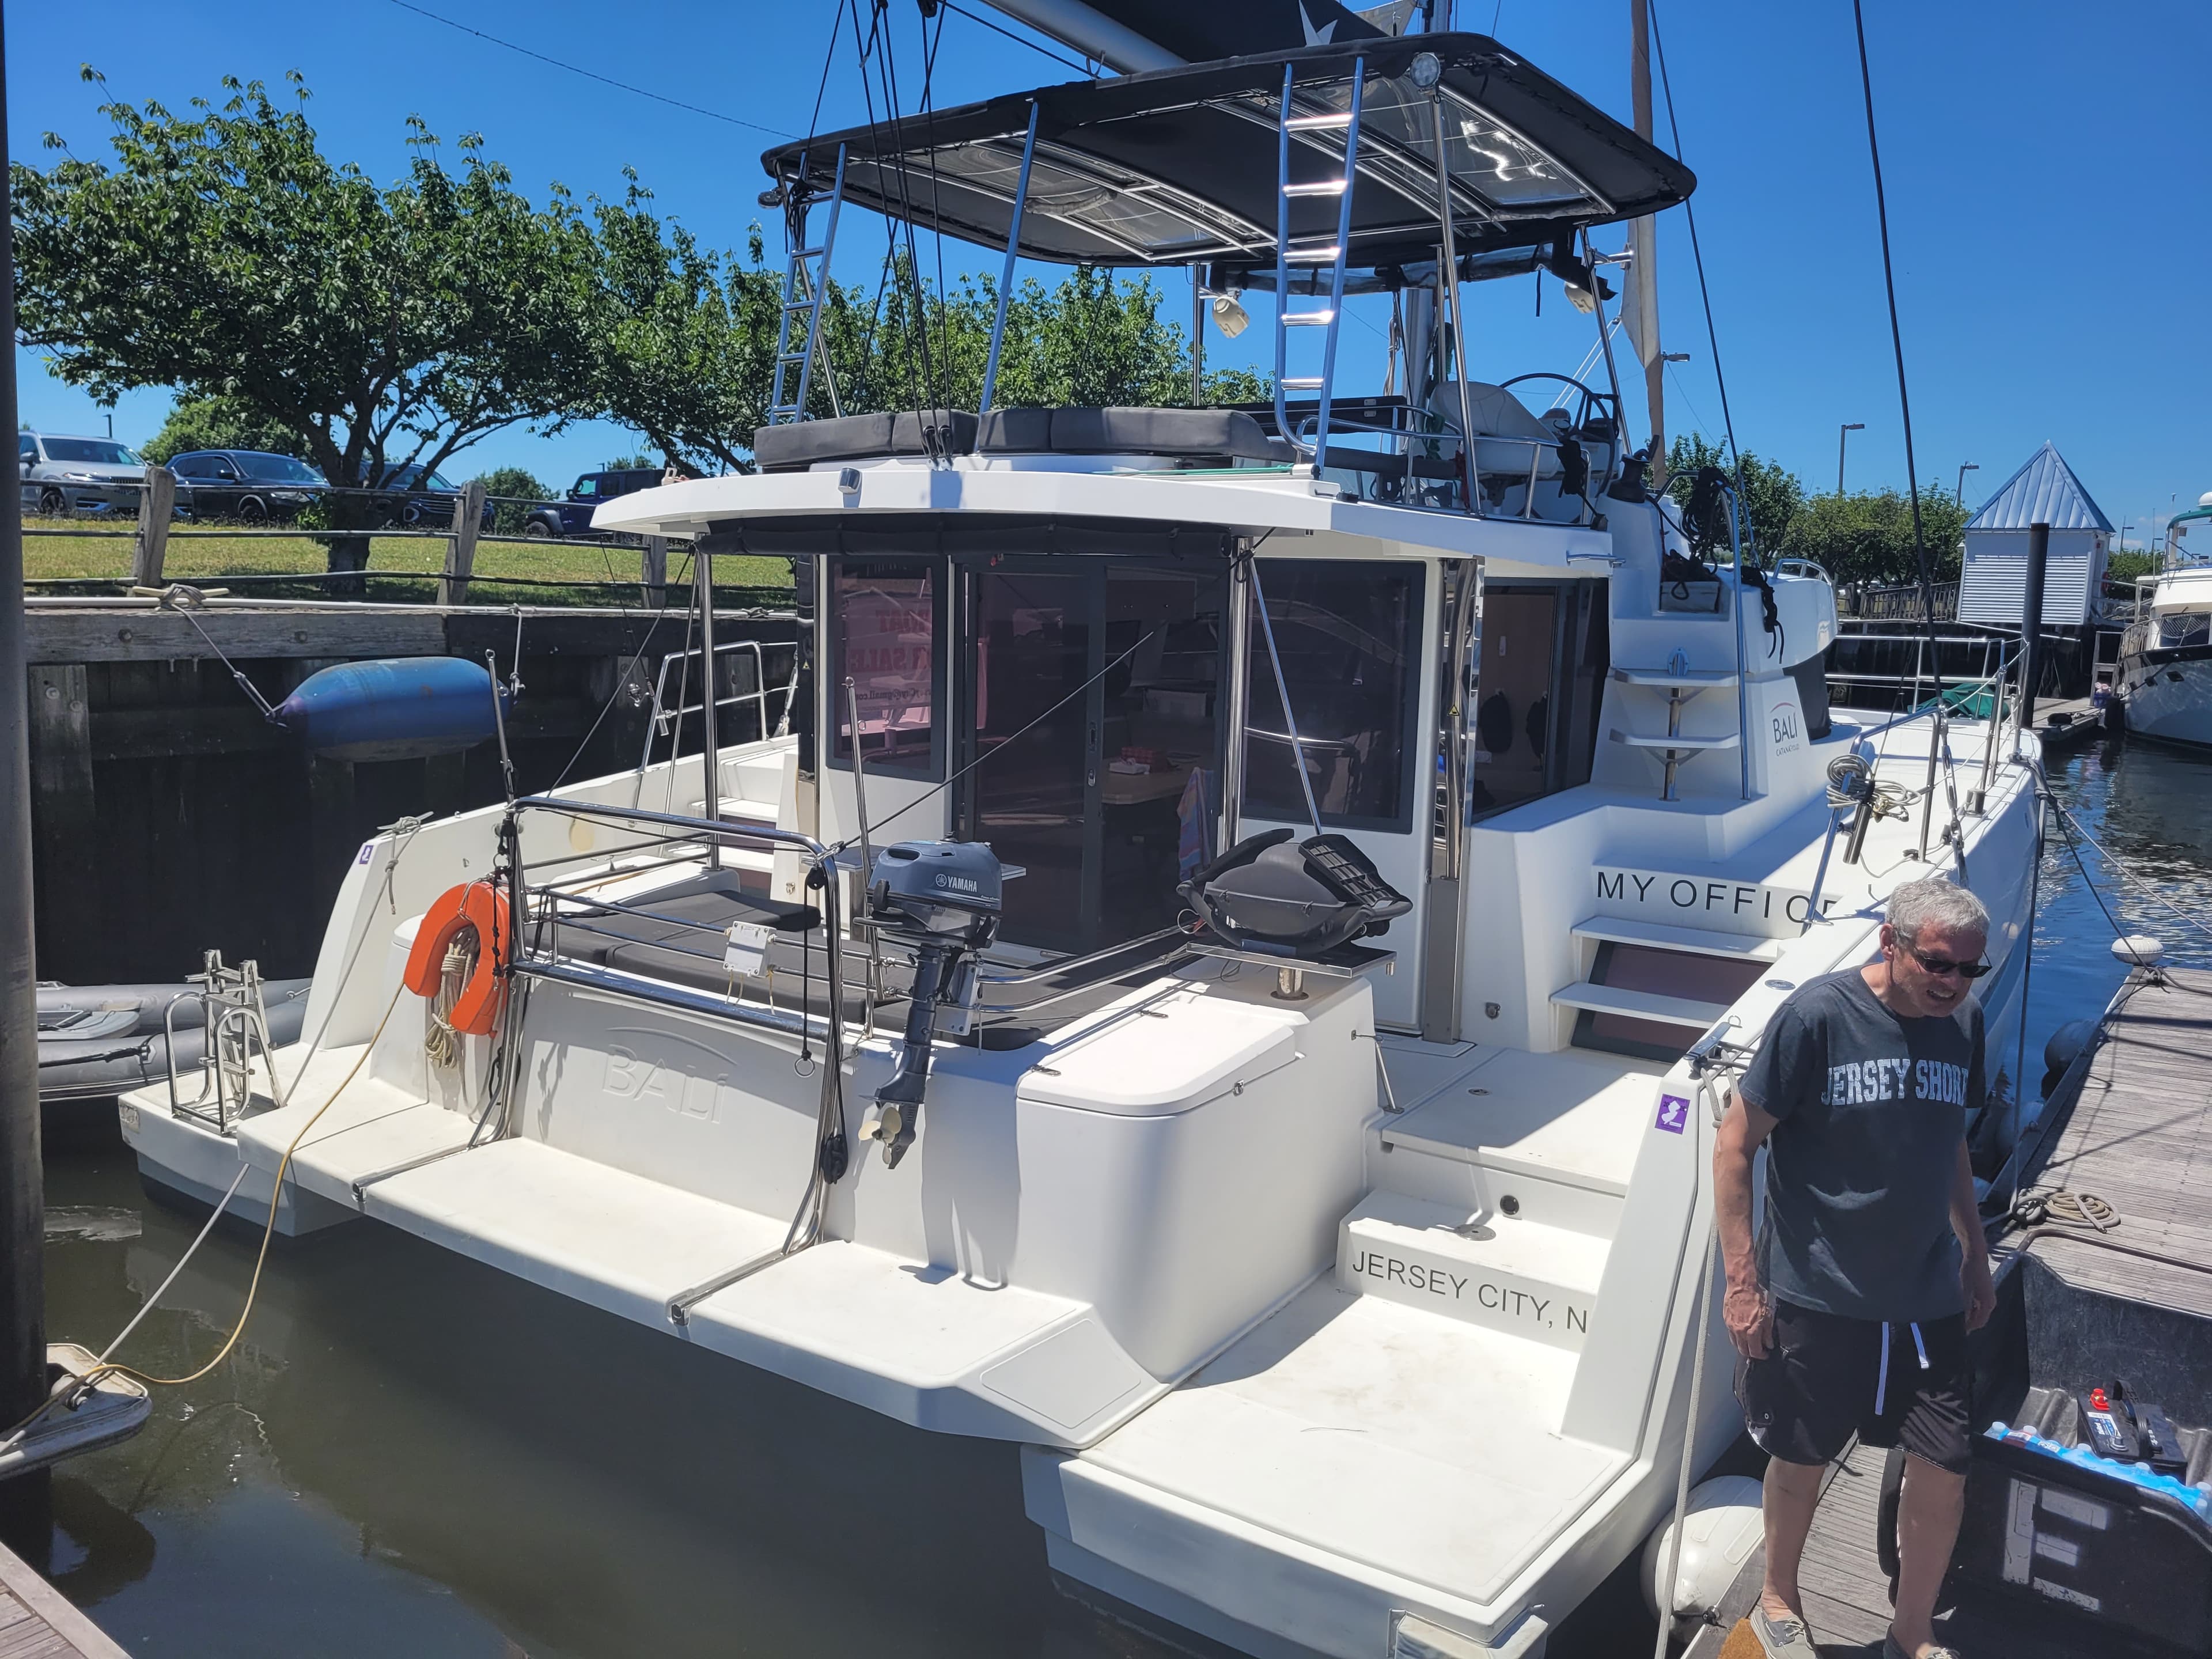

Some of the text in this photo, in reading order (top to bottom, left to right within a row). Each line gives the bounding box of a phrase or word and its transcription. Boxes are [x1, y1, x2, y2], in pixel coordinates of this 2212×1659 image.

[948, 876, 977, 892] YAMAHA
[1597, 872, 1656, 902] MY
[1821, 1058, 1911, 1106] JERSEY
[1352, 1251, 1468, 1300] JERSEY
[1478, 1284, 1553, 1329] CITY,
